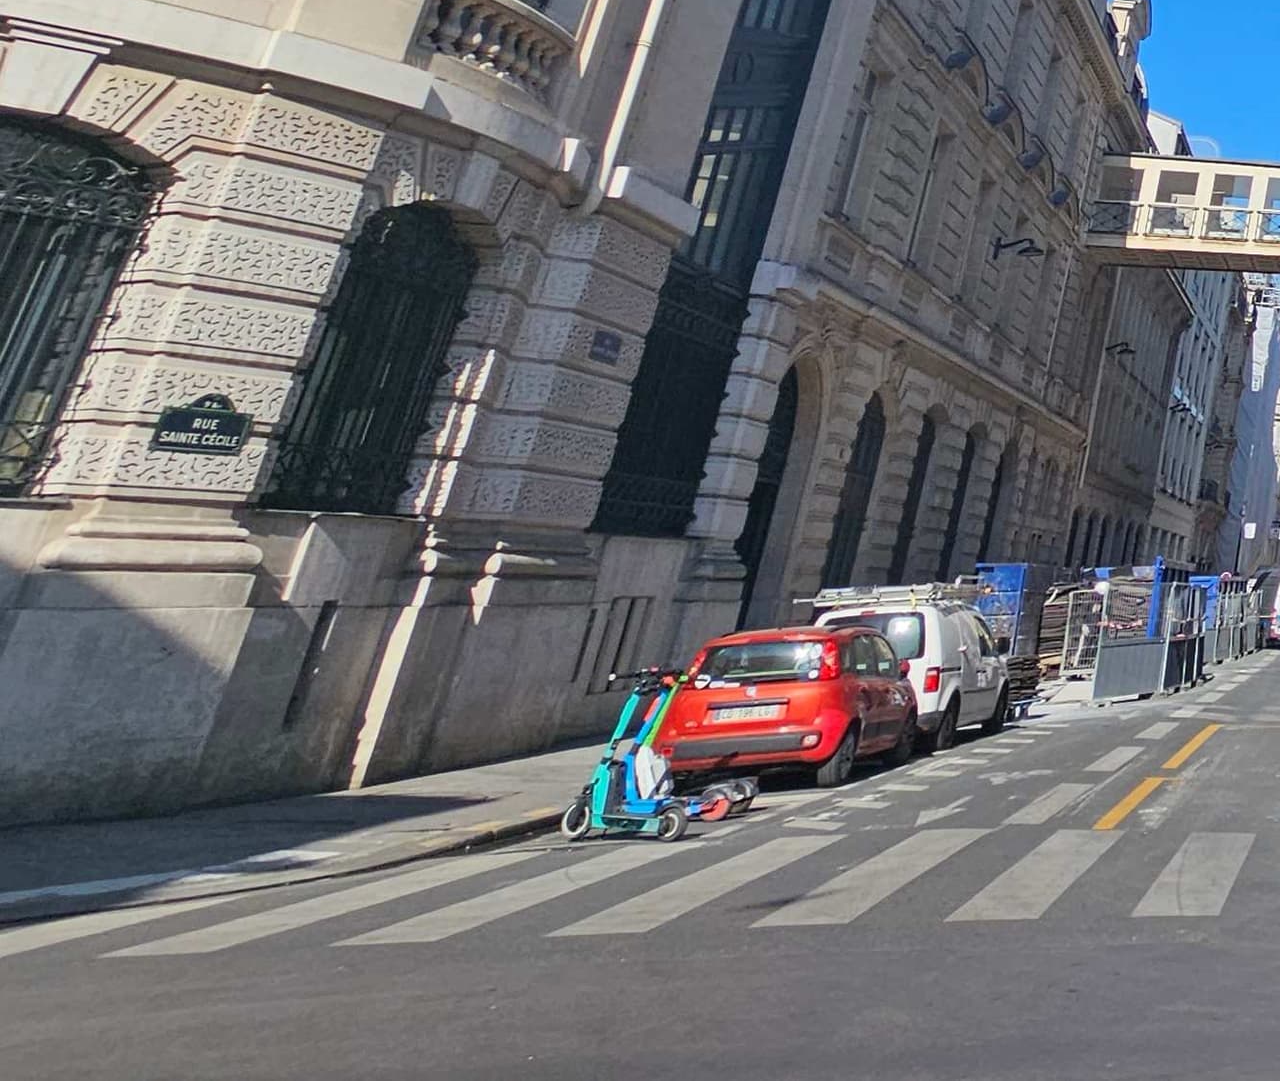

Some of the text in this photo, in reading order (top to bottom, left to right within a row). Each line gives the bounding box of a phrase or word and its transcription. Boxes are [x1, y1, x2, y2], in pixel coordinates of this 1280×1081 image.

[192, 418, 220, 430] RUE
[158, 430, 240, 447] SAINTE CÉCILE
